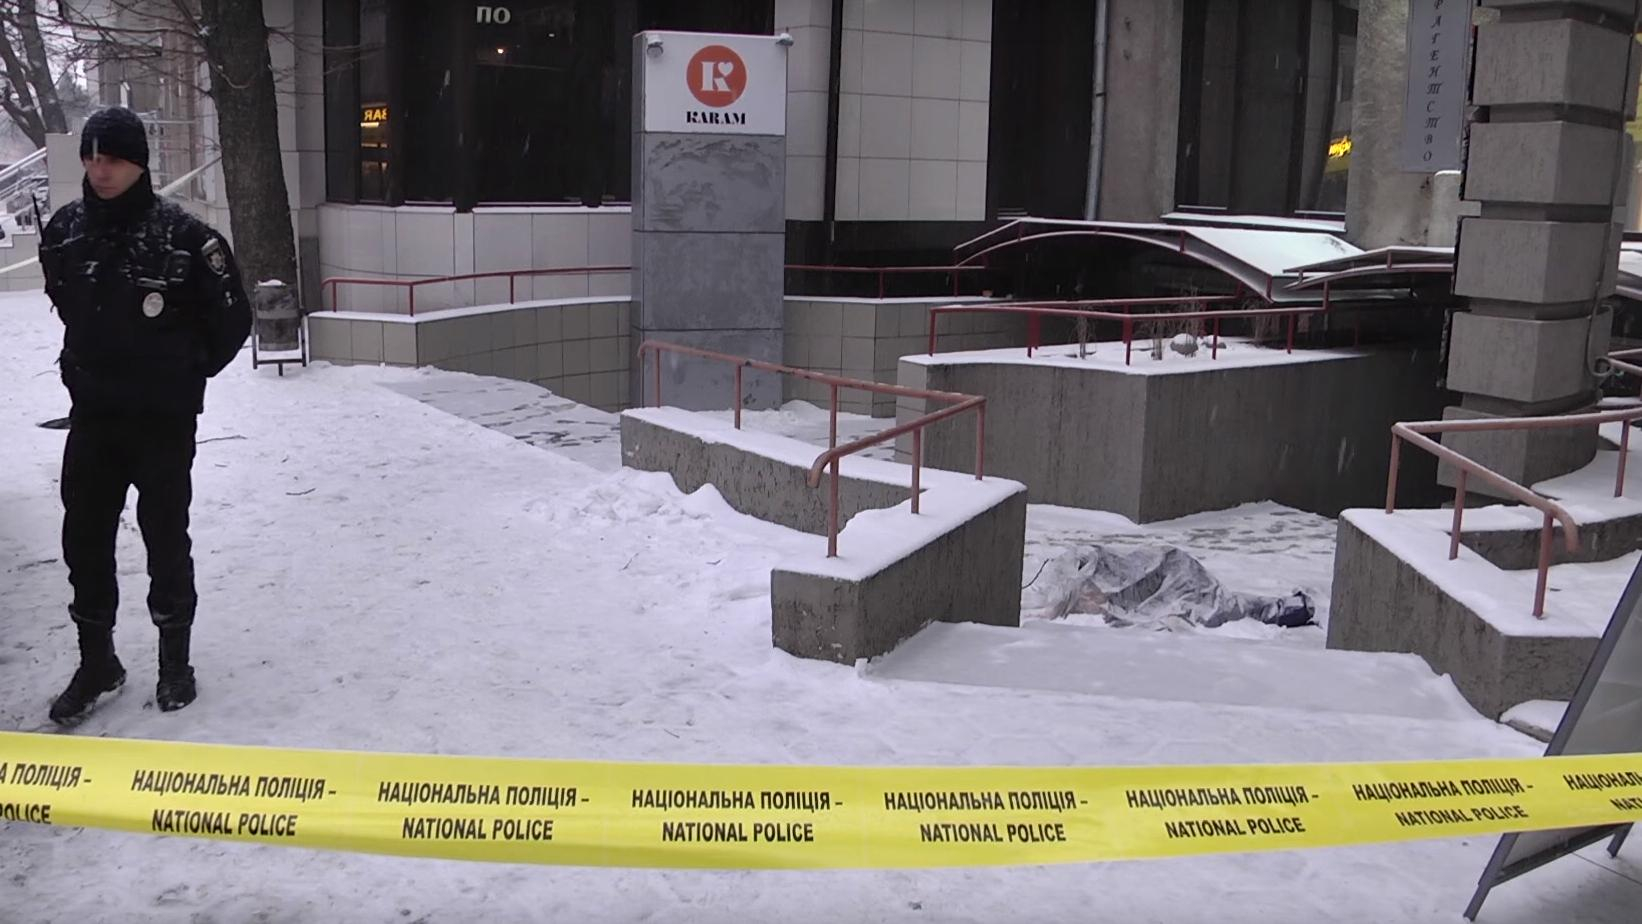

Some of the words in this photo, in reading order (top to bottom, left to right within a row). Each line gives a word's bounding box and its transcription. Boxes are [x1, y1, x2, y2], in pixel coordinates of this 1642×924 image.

[686, 111, 746, 125] KARAM
[10, 763, 82, 791] ПОЛІЦІЯ
[131, 770, 250, 796] НАЦІОНАЛЬНА
[255, 777, 325, 803] ПОЛІЦІЯ
[378, 782, 500, 806] НАЦІОНАЛЬНА
[505, 785, 576, 810] ПОЛІЦІЯ
[632, 789, 755, 811] НАЦІОНАЛЬНА
[761, 791, 830, 814] ПОЛІЦІЯ
[884, 791, 1005, 813] НАЦІОНАЛЬНА
[1008, 791, 1076, 813] ПОЛІЦІЯ
[1126, 787, 1242, 811] НАЦІОНАЛЬНА
[1243, 786, 1309, 806] ПОЛІЦІЯ
[1352, 781, 1460, 803] НАЦІОНАЛЬНА
[1460, 778, 1525, 797] ПОЛІЦІЯ
[152, 809, 233, 835] NATIONAL
[238, 813, 298, 837] POLICE
[1165, 819, 1246, 838] NATIONAL
[1247, 817, 1306, 836] POLICE
[1395, 808, 1473, 826] NATIONAL
[1471, 805, 1528, 821] POLICE
[403, 817, 486, 840] NATIONAL
[492, 819, 554, 840] POLICE
[663, 822, 748, 842] NATIONAL
[754, 823, 814, 842] POLICE
[920, 824, 1003, 843] NATIONAL
[1007, 823, 1067, 843] POLICE
